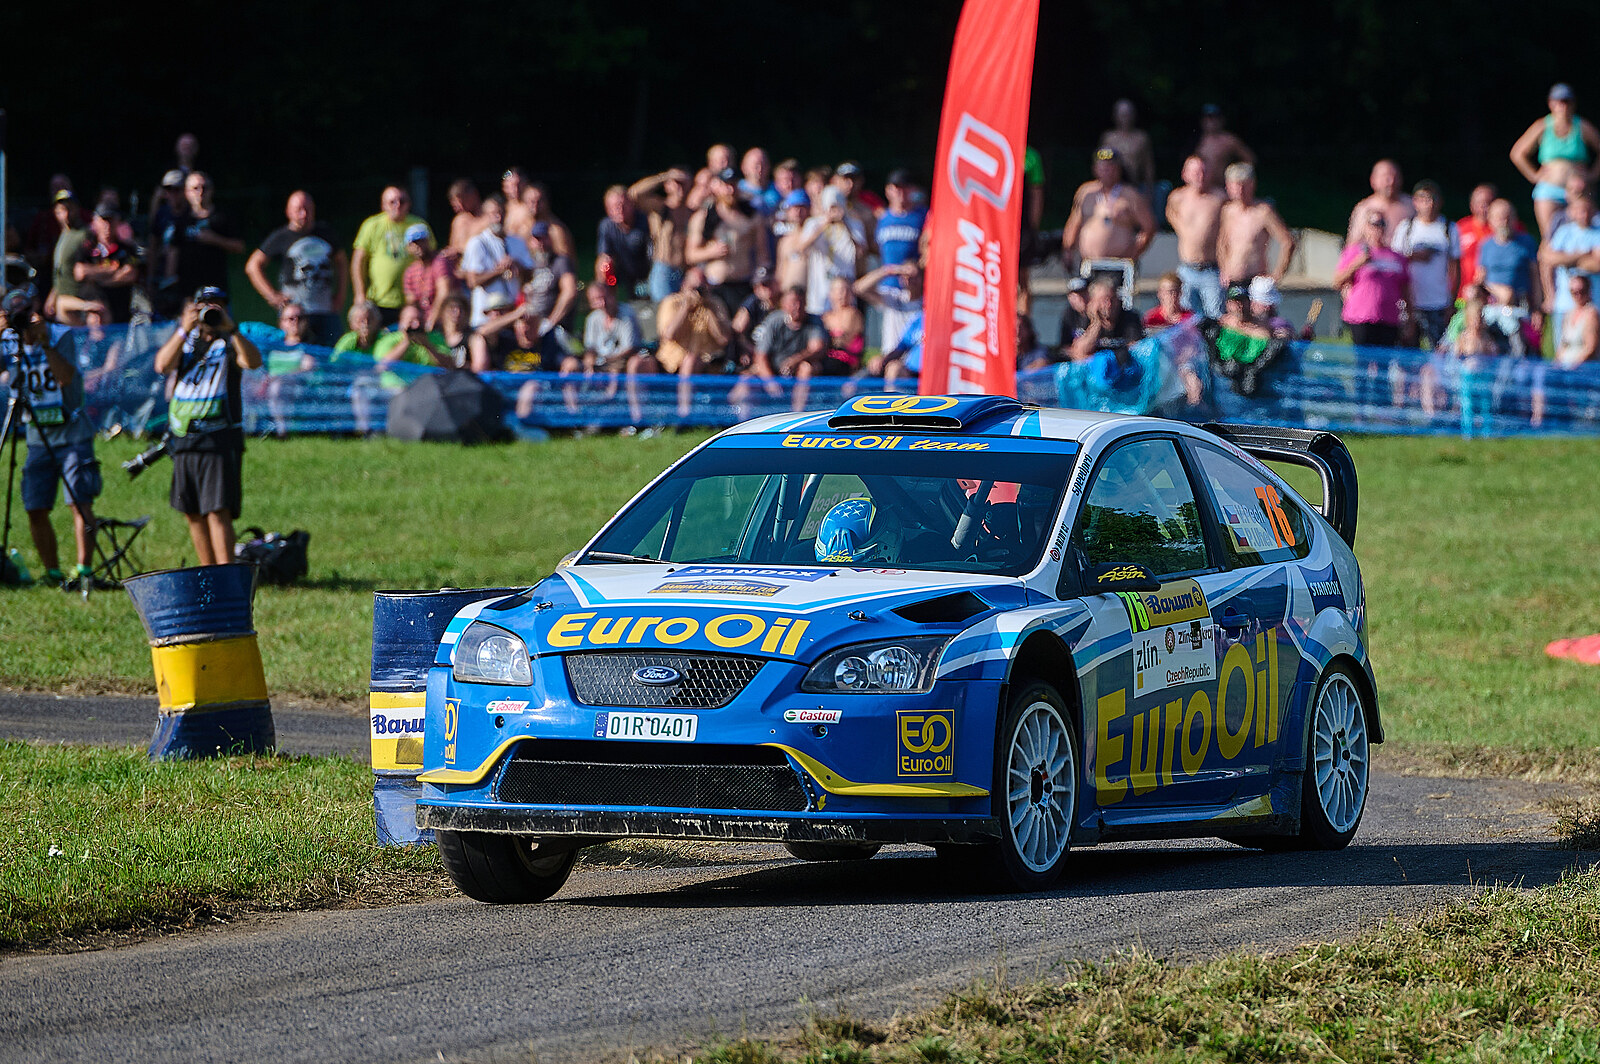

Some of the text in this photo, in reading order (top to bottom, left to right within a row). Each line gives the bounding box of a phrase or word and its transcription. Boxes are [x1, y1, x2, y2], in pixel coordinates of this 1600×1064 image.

[908, 438, 990, 451] team
[1253, 484, 1296, 548] 76
[685, 568, 820, 578] STANDOX
[1309, 580, 1342, 597] STANDOX
[1145, 592, 1194, 615] Barum
[1114, 591, 1150, 633] 76
[643, 668, 667, 680] Ford
[496, 702, 524, 712] Castrol
[799, 710, 837, 722] Castrol
[610, 716, 644, 736] 01R
[649, 717, 693, 738] 0401
